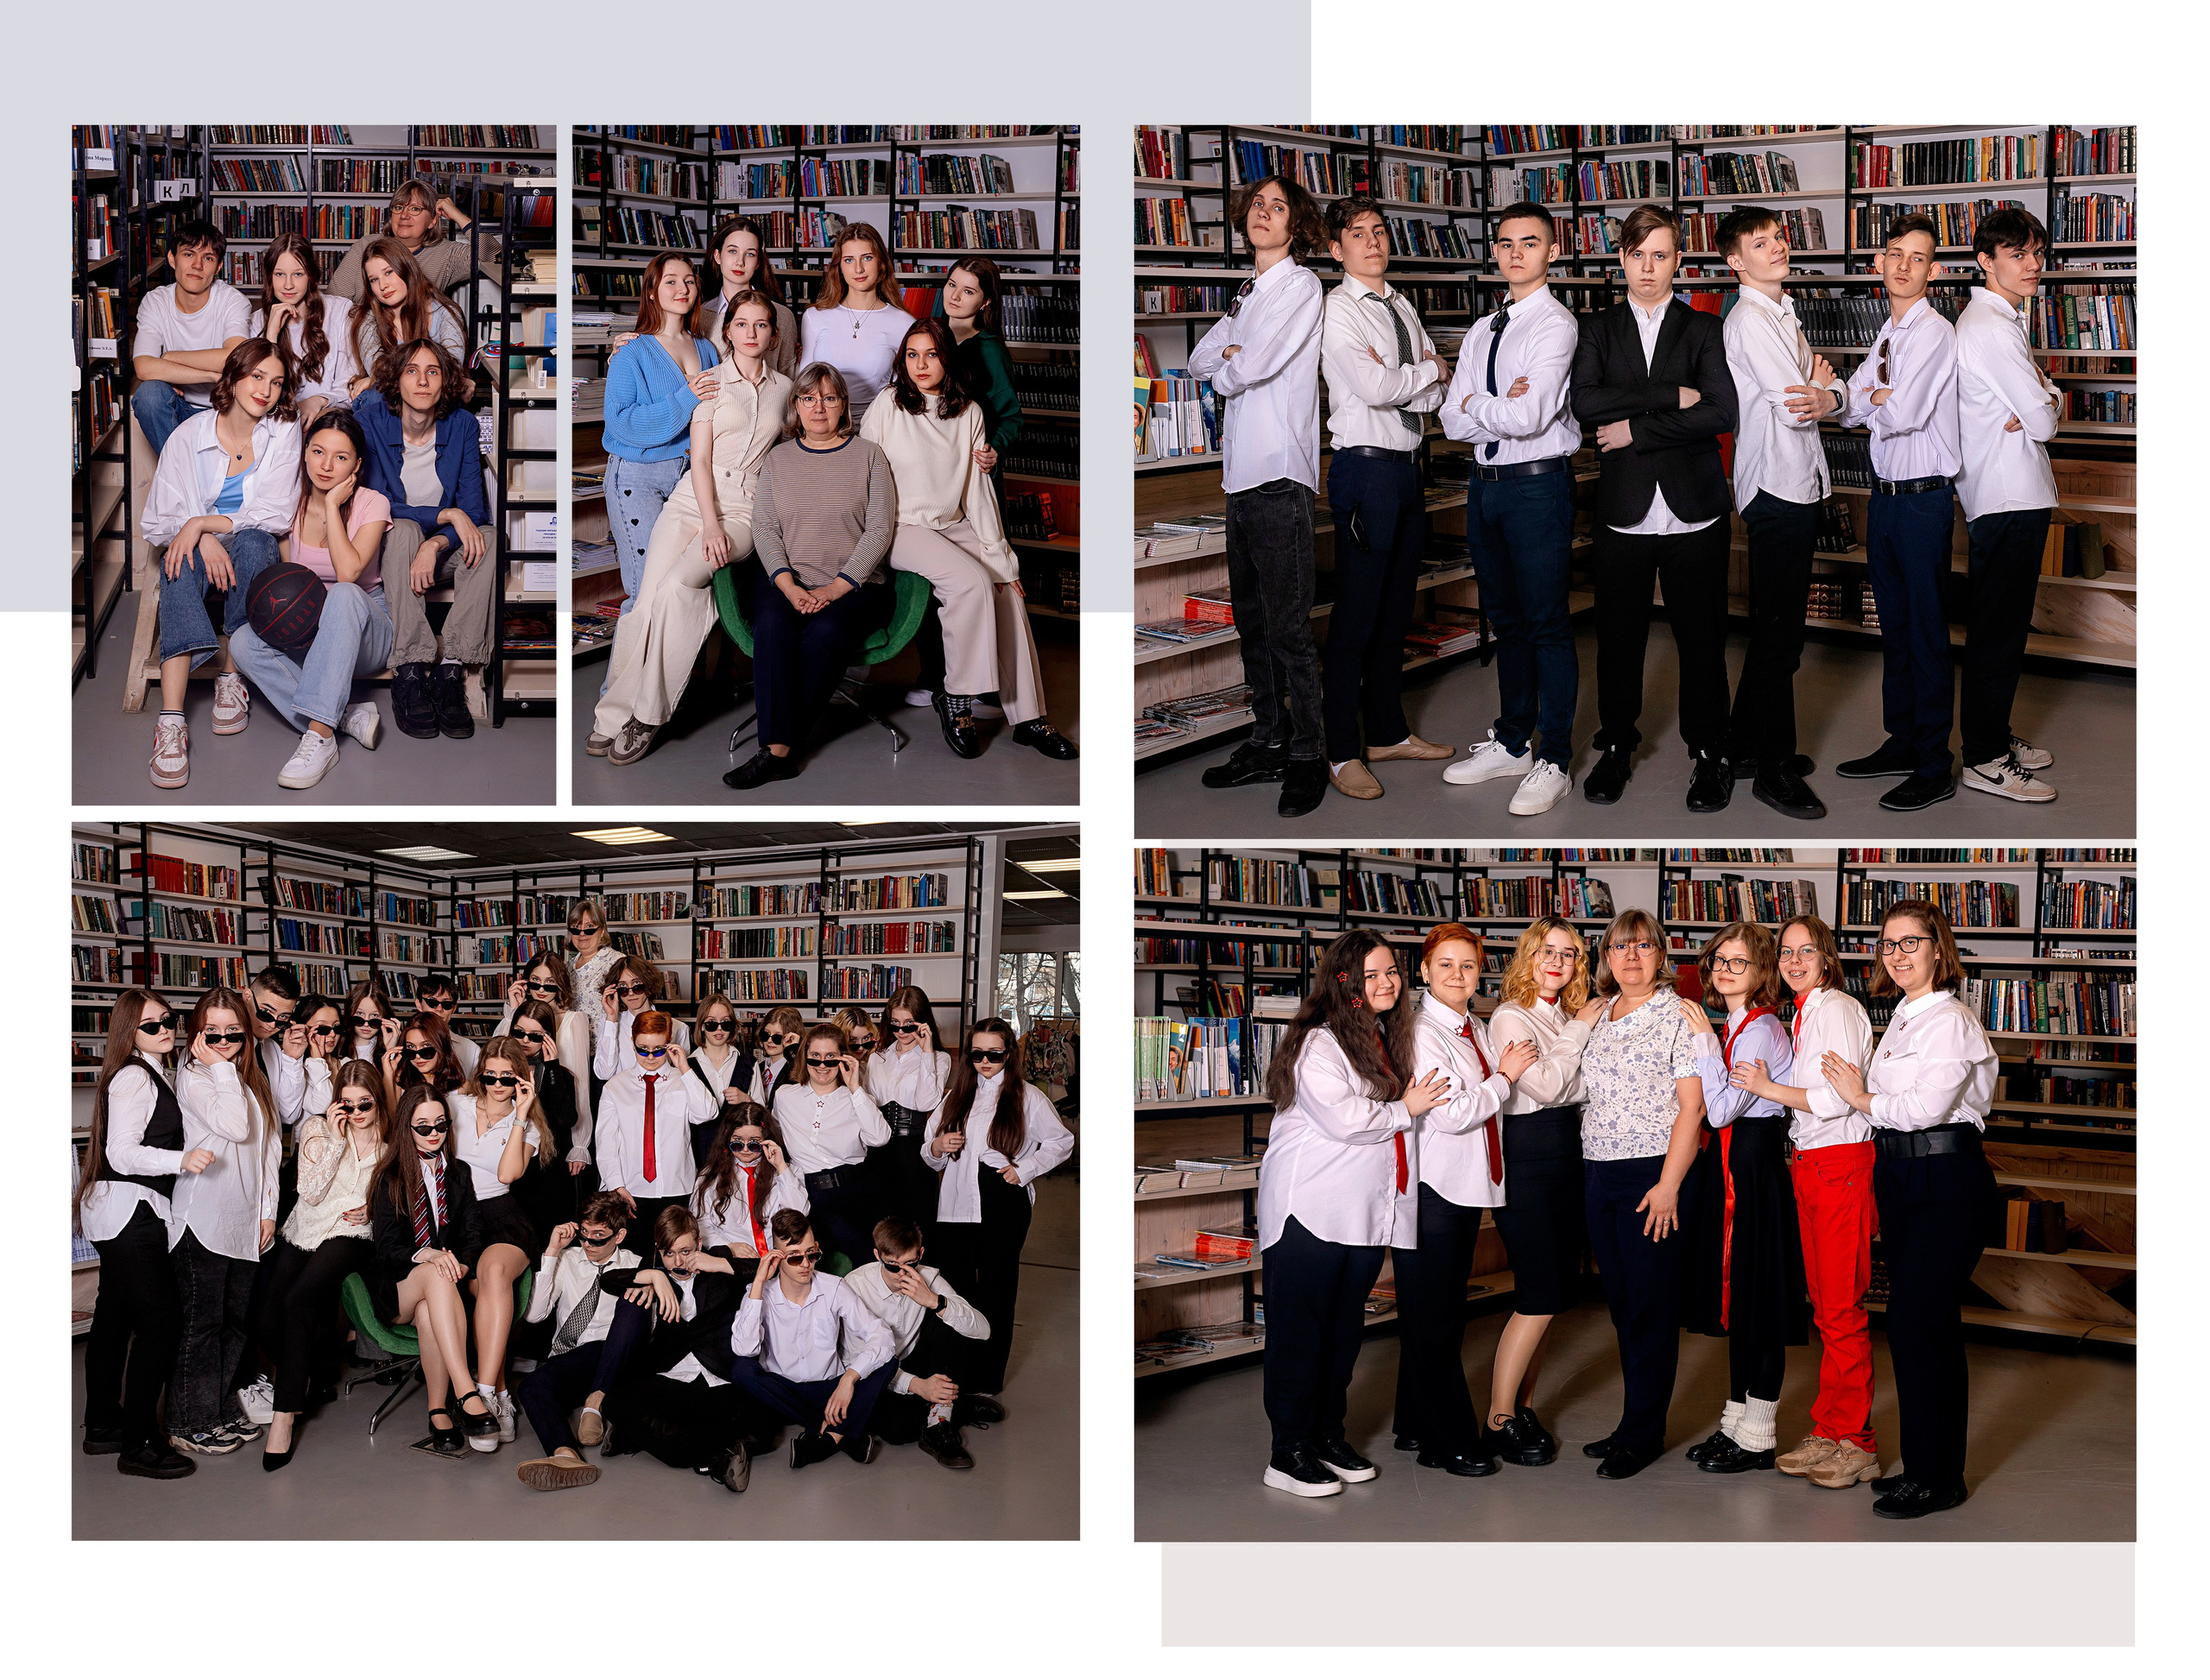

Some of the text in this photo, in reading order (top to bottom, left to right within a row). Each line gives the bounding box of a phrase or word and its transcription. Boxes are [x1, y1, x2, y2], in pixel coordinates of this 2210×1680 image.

[163, 186, 173, 199] К
[180, 183, 190, 194] Л
[1150, 296, 1158, 310] К
[275, 599, 316, 640] JORDAN
[1556, 900, 1562, 911] Р
